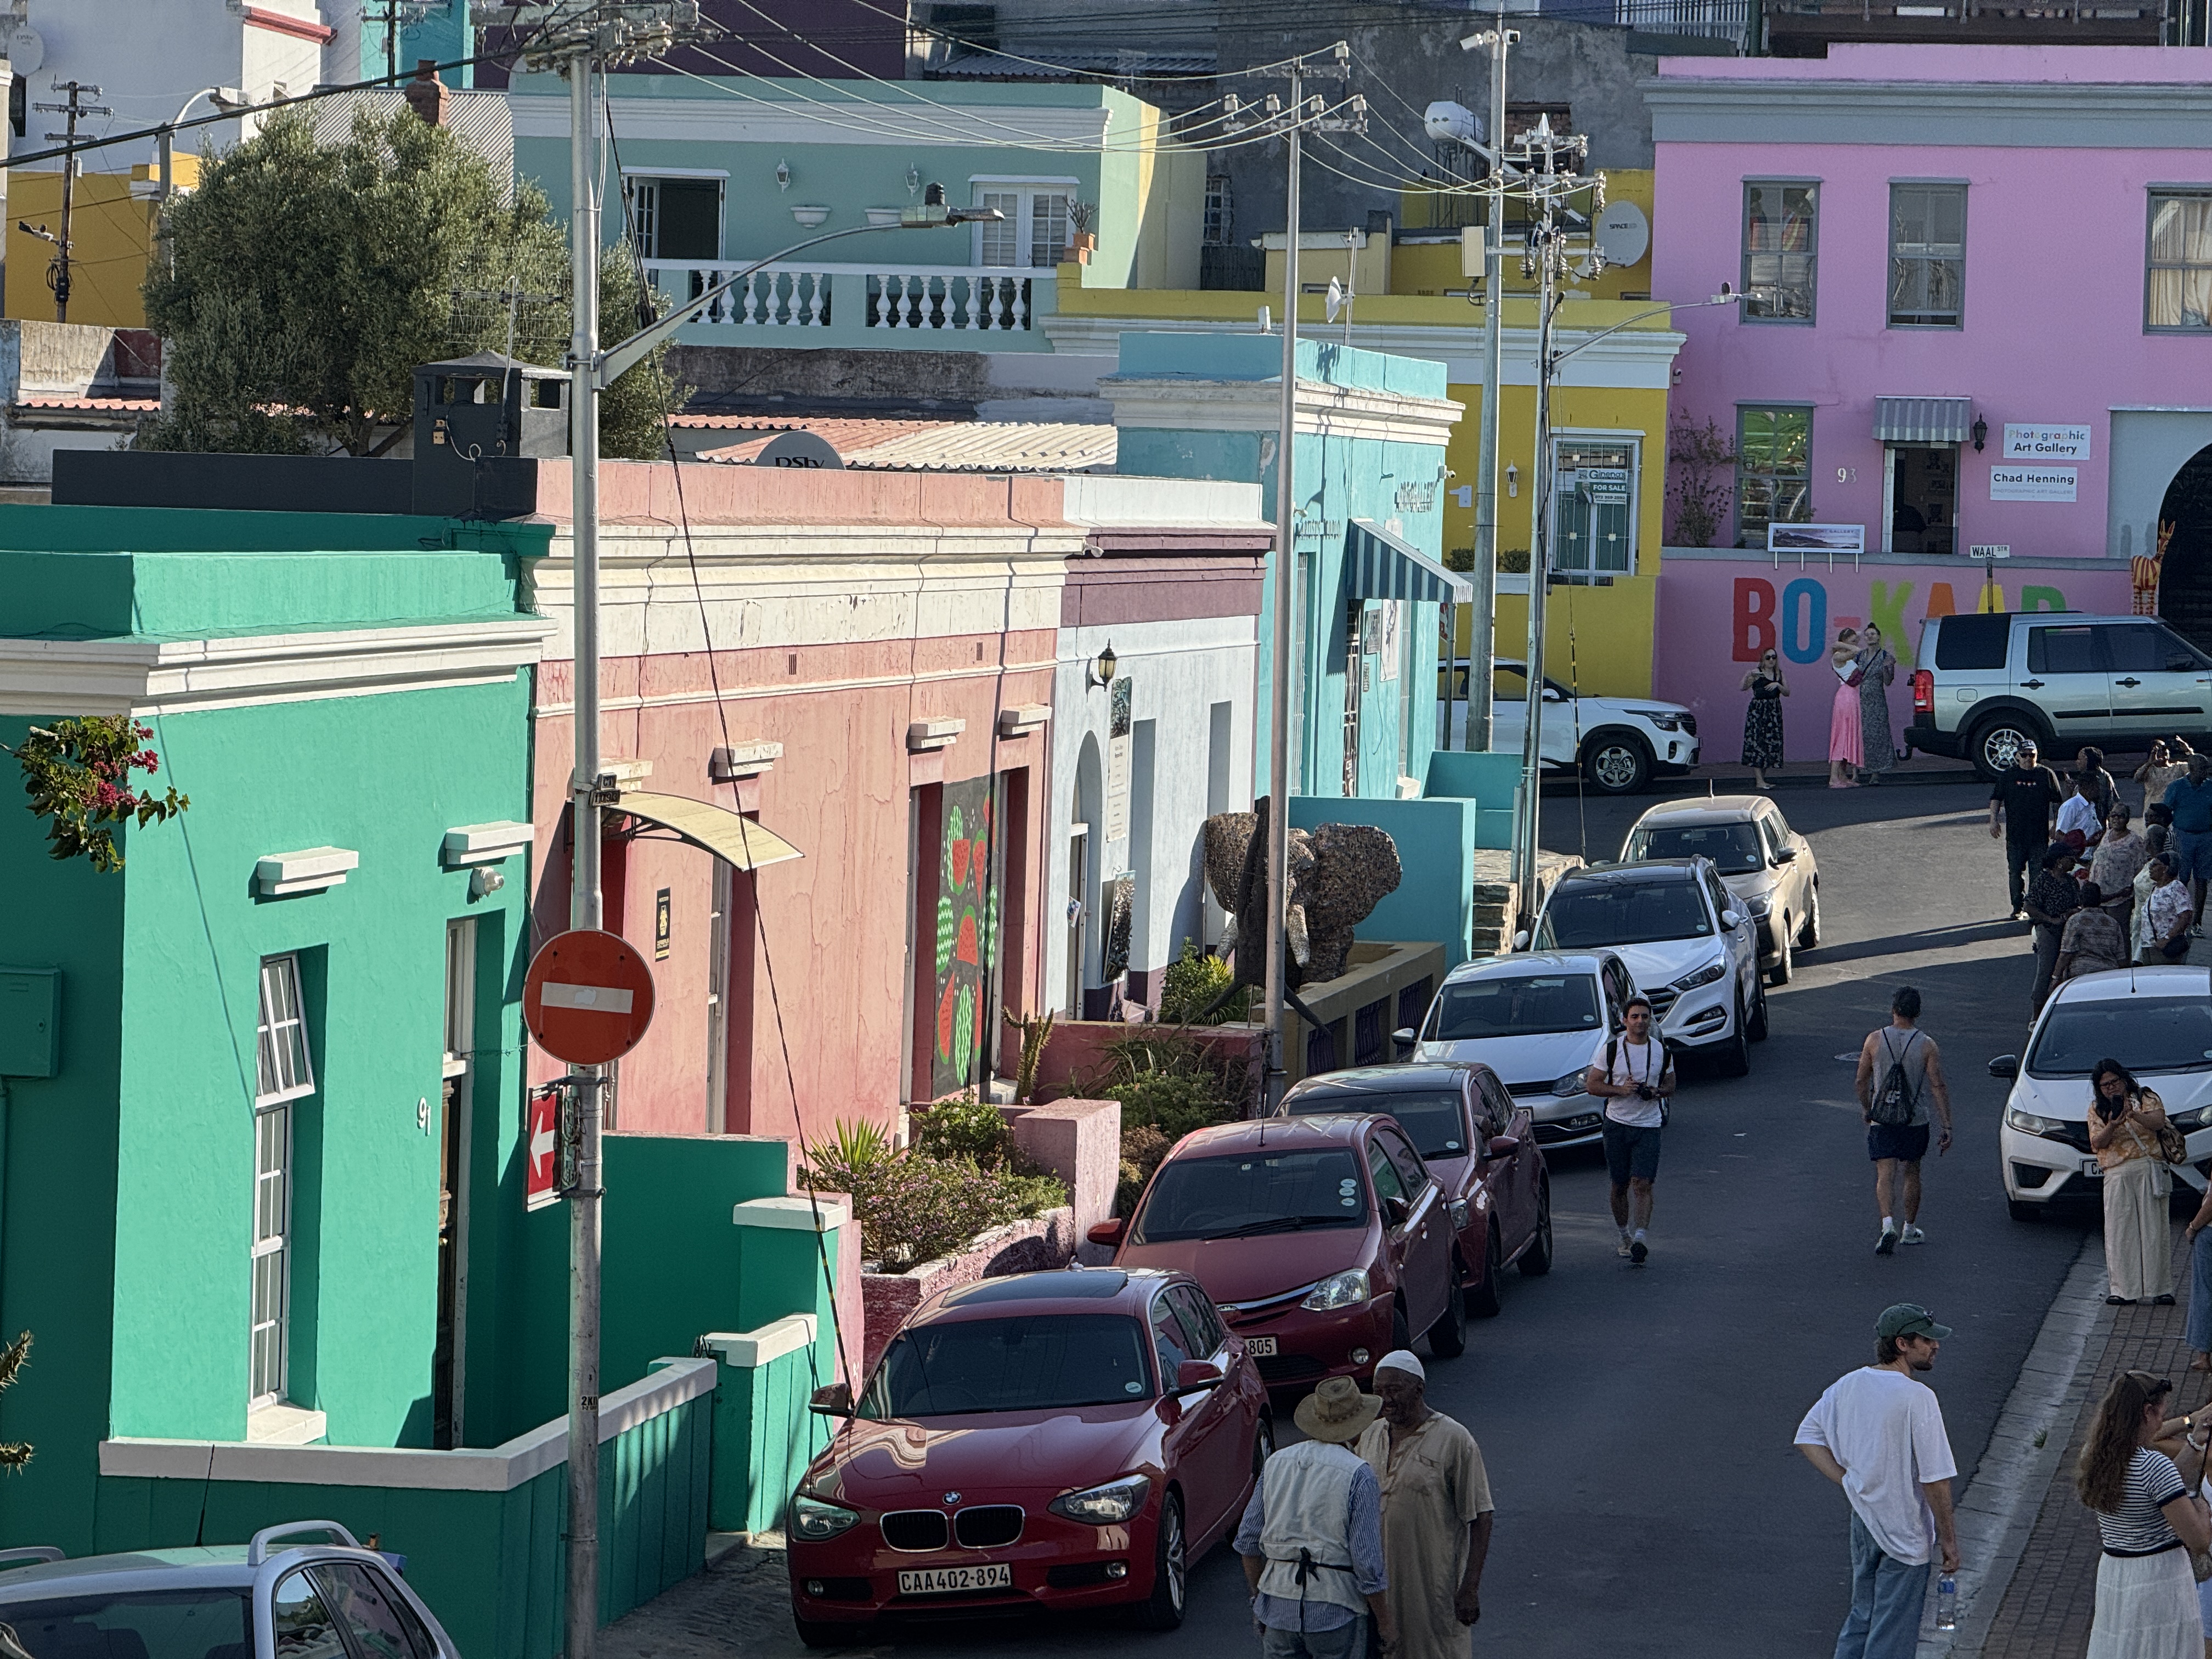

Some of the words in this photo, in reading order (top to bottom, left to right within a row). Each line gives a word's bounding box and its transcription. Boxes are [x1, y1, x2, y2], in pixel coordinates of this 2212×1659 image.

[2008, 430, 2085, 442] Photographic
[2014, 443, 2032, 452] Art
[2035, 443, 2078, 455] Gallery
[1993, 473, 2023, 482] Chad
[2027, 474, 2075, 485] Henning
[1972, 546, 1996, 557] WAAL
[419, 1097, 431, 1136] 91
[1249, 1339, 1272, 1355] 805
[901, 1566, 1009, 1592] CAA402-894
